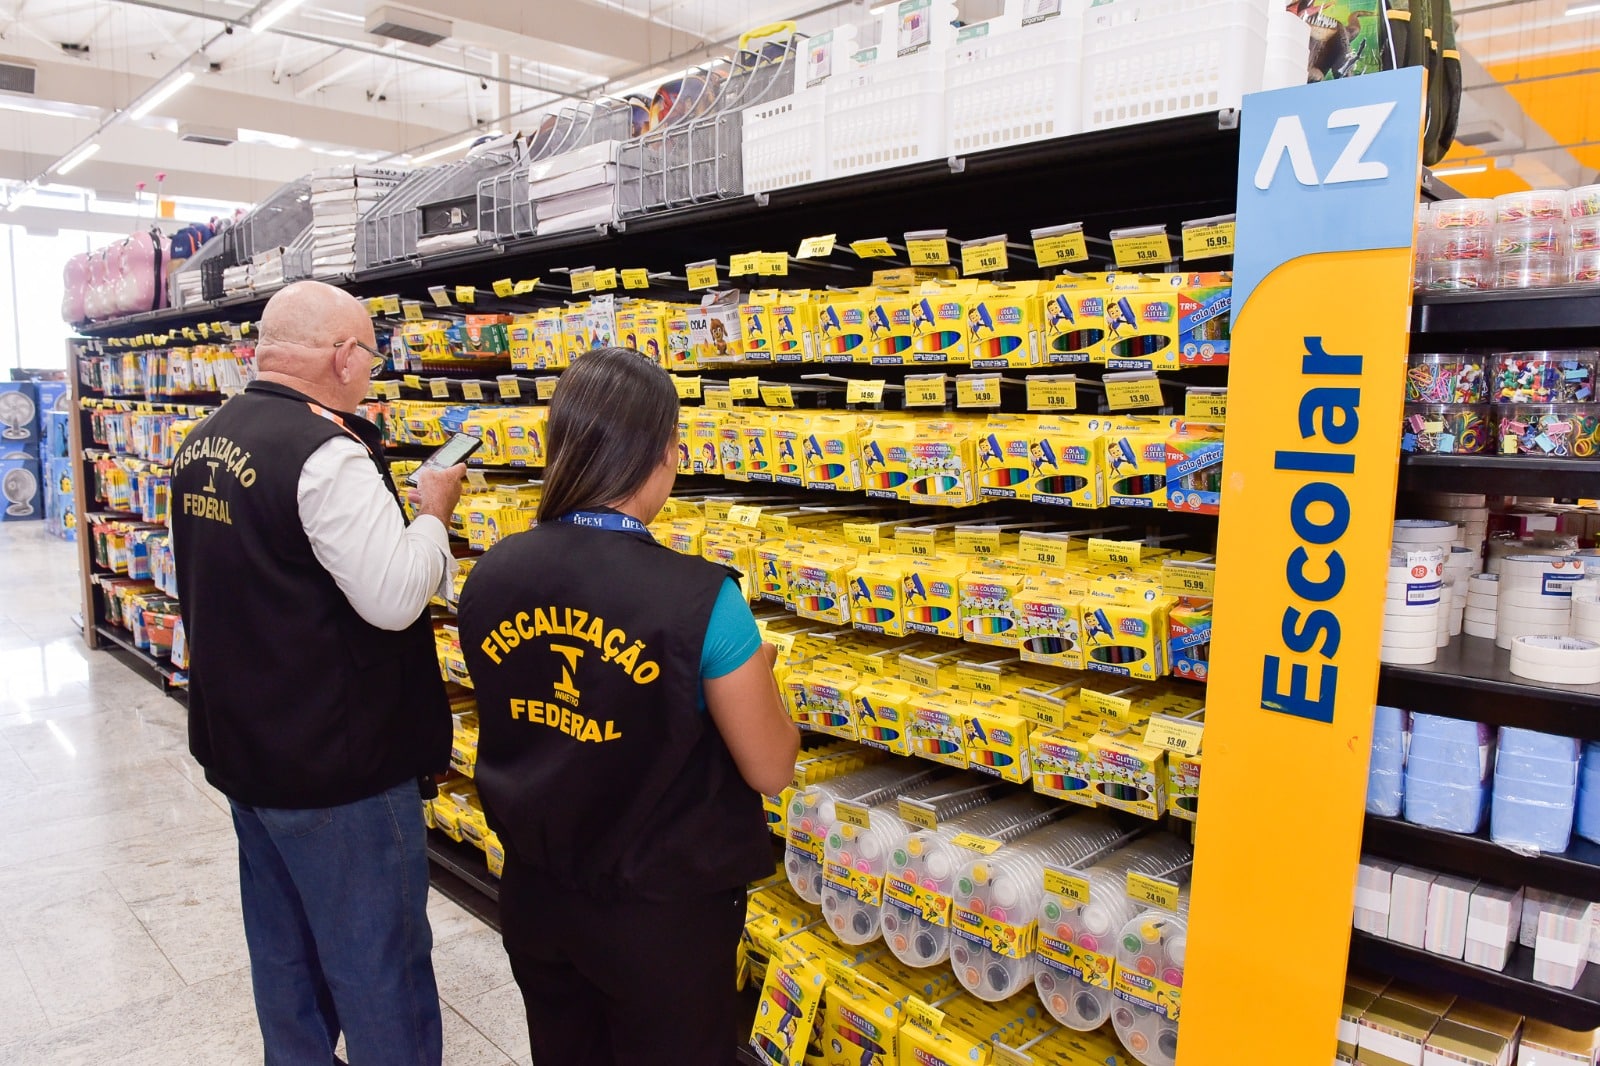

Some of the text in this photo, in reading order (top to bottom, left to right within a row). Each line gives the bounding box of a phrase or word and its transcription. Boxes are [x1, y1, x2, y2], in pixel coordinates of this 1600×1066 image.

[1254, 101, 1398, 191] AZ
[1179, 302, 1197, 310] TRIS
[1210, 297, 1231, 316] glitte
[690, 320, 707, 330] COLA
[173, 436, 257, 489] FISCALIZAÇÃO
[1167, 452, 1184, 460] TRIS
[1178, 450, 1221, 472] cola glitter
[183, 493, 233, 526] FEDERAL
[1260, 335, 1363, 726] Escolar
[1040, 605, 1064, 616] GLITTER
[1122, 619, 1137, 627] COLA
[1172, 625, 1188, 634] TRIS
[480, 606, 660, 690] FISCALIZAÇÃO
[510, 698, 622, 744] FEDERAL
[1119, 969, 1154, 989] AQUARELA
[852, 1013, 876, 1034] GLITTER
